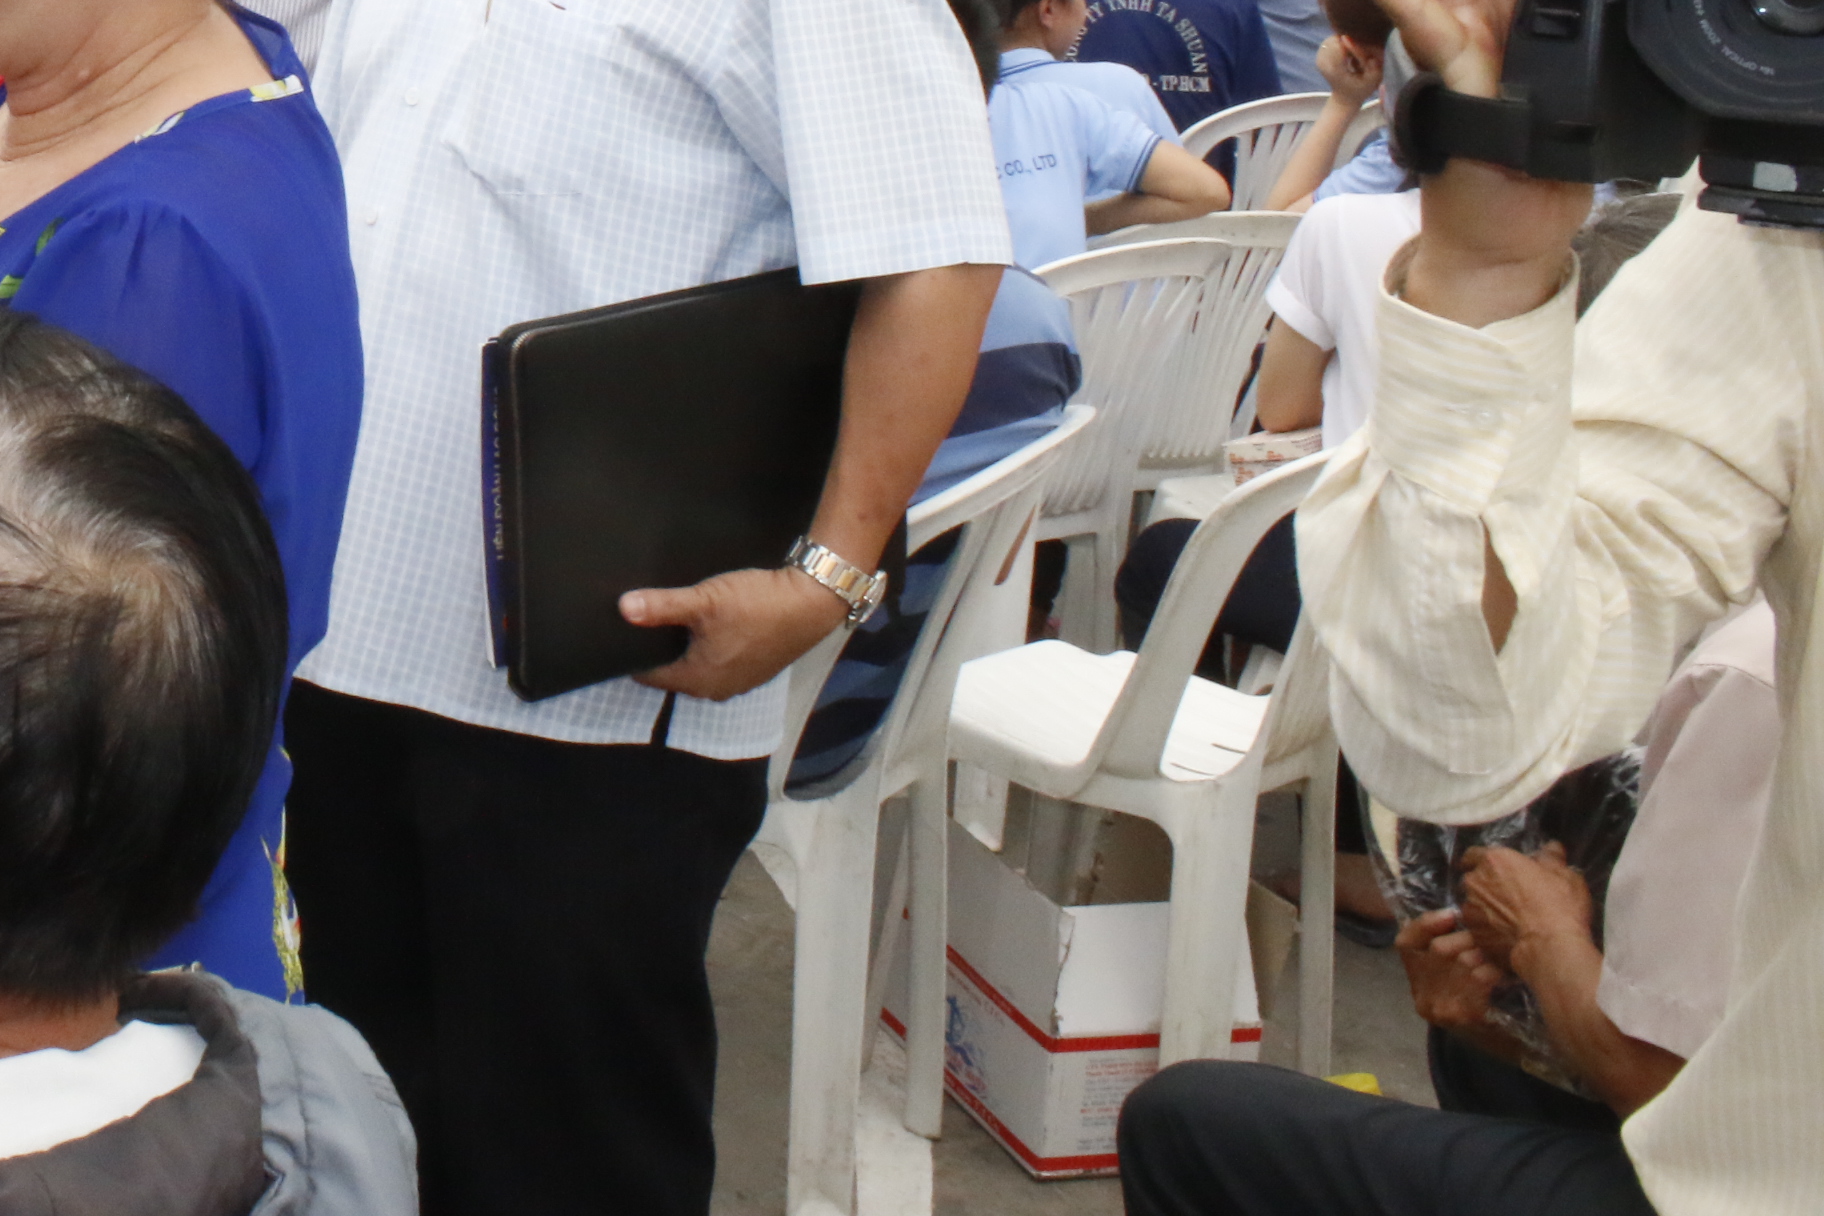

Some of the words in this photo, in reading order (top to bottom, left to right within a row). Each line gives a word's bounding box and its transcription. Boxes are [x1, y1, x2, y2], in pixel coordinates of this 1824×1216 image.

[1155, 1, 1178, 23] TA
[1174, 17, 1209, 74] SHUAN
[1032, 153, 1057, 171] LTD
